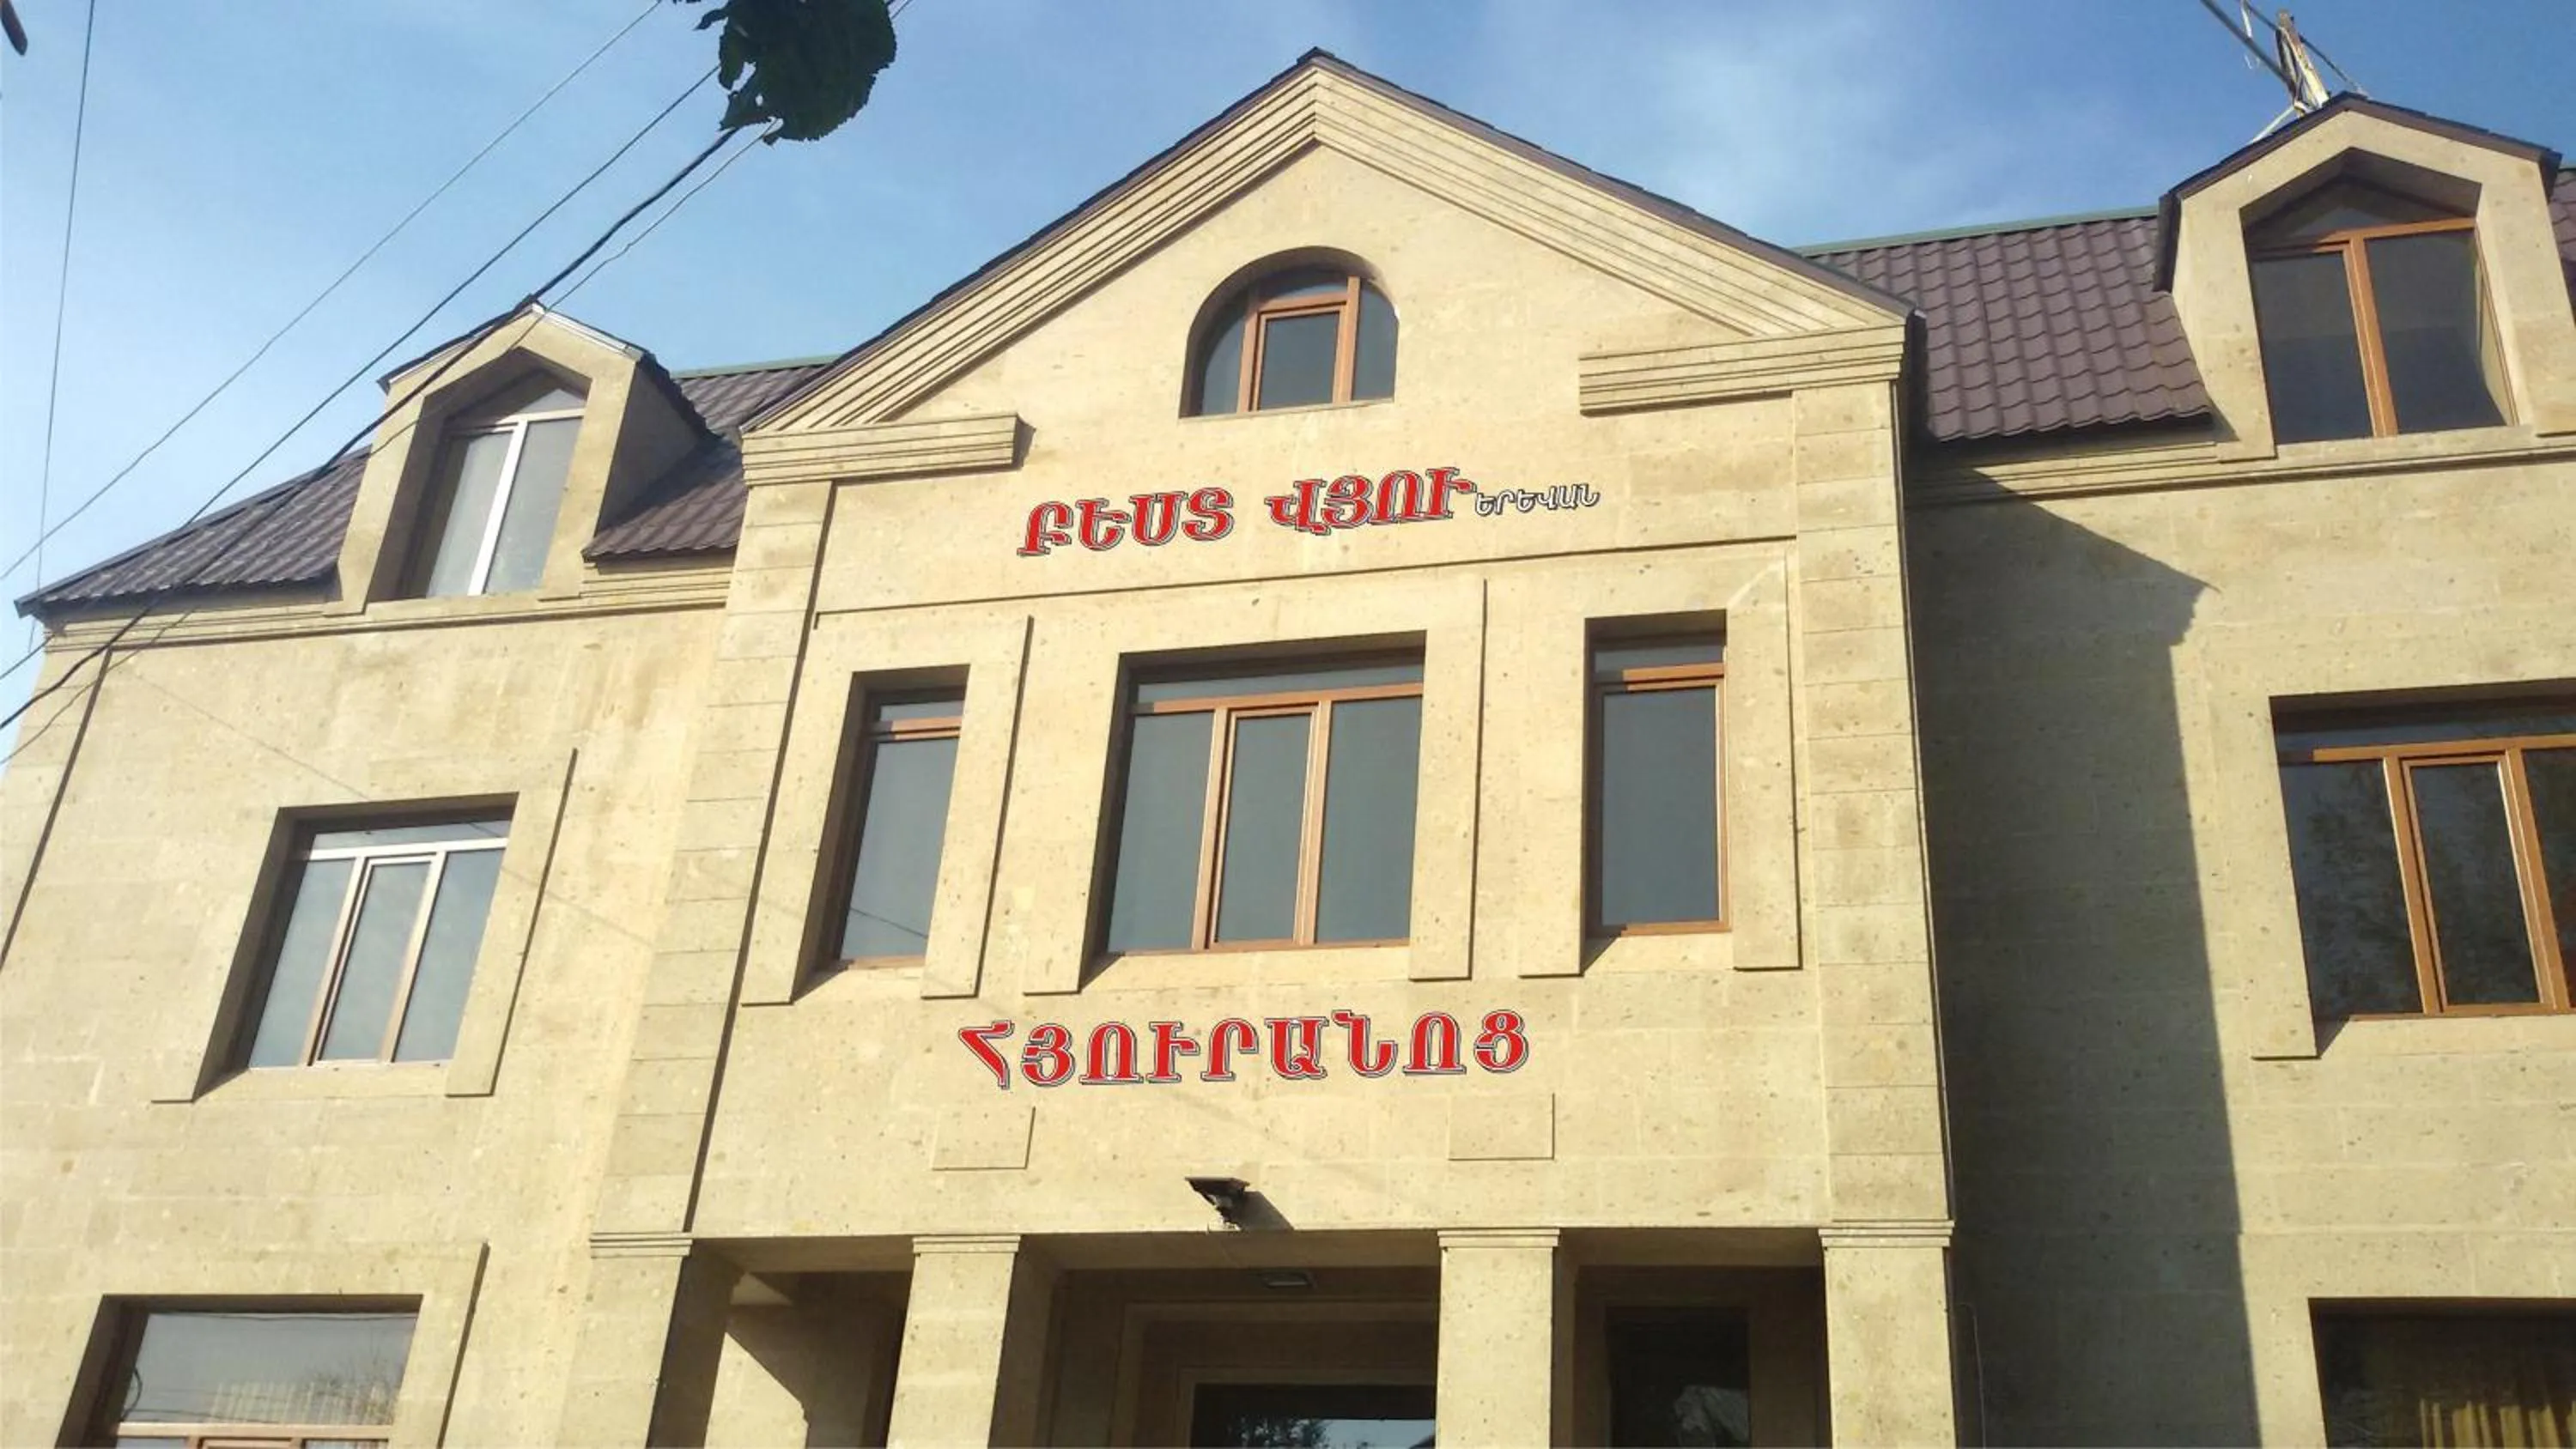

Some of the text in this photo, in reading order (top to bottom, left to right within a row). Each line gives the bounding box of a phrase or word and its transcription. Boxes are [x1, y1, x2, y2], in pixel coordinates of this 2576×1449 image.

[1017, 467, 1601, 556] ԲԵՍՏ ՎՅՈՒ ԵՐԵՎԱՆ
[958, 1009, 1529, 1090] ՀՅՈՒՐԱՆՈՑ
